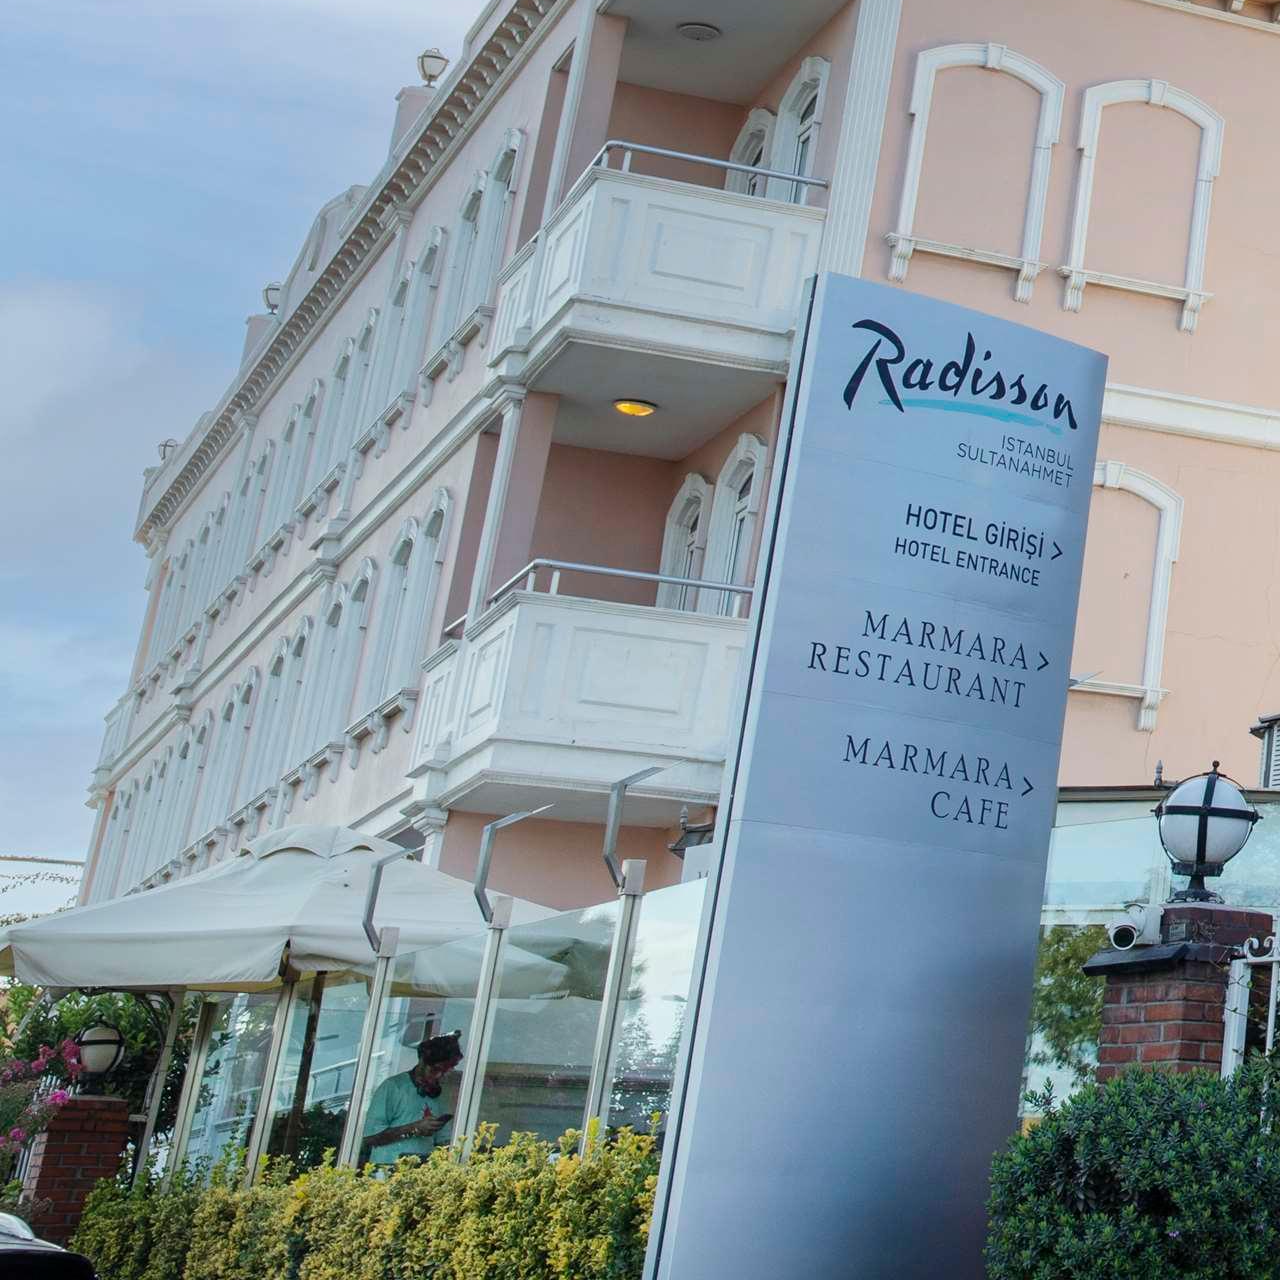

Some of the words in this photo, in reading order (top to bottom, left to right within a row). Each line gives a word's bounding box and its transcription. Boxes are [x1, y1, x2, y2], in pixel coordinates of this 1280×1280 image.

[843, 319, 1078, 430] Radisson
[956, 442, 1073, 489] SULTANAHMET
[1001, 434, 1074, 471] ISTANBUL
[906, 503, 978, 541] HOTEL
[985, 521, 1045, 560] GİRİŞİ
[894, 537, 951, 565] HOTEL
[955, 550, 1041, 587] ENTRANCE
[862, 609, 1029, 670] MARMARA
[807, 641, 1026, 708] RESTAURANT
[843, 734, 1013, 790] MARMARA
[930, 791, 1009, 830] CAFE
